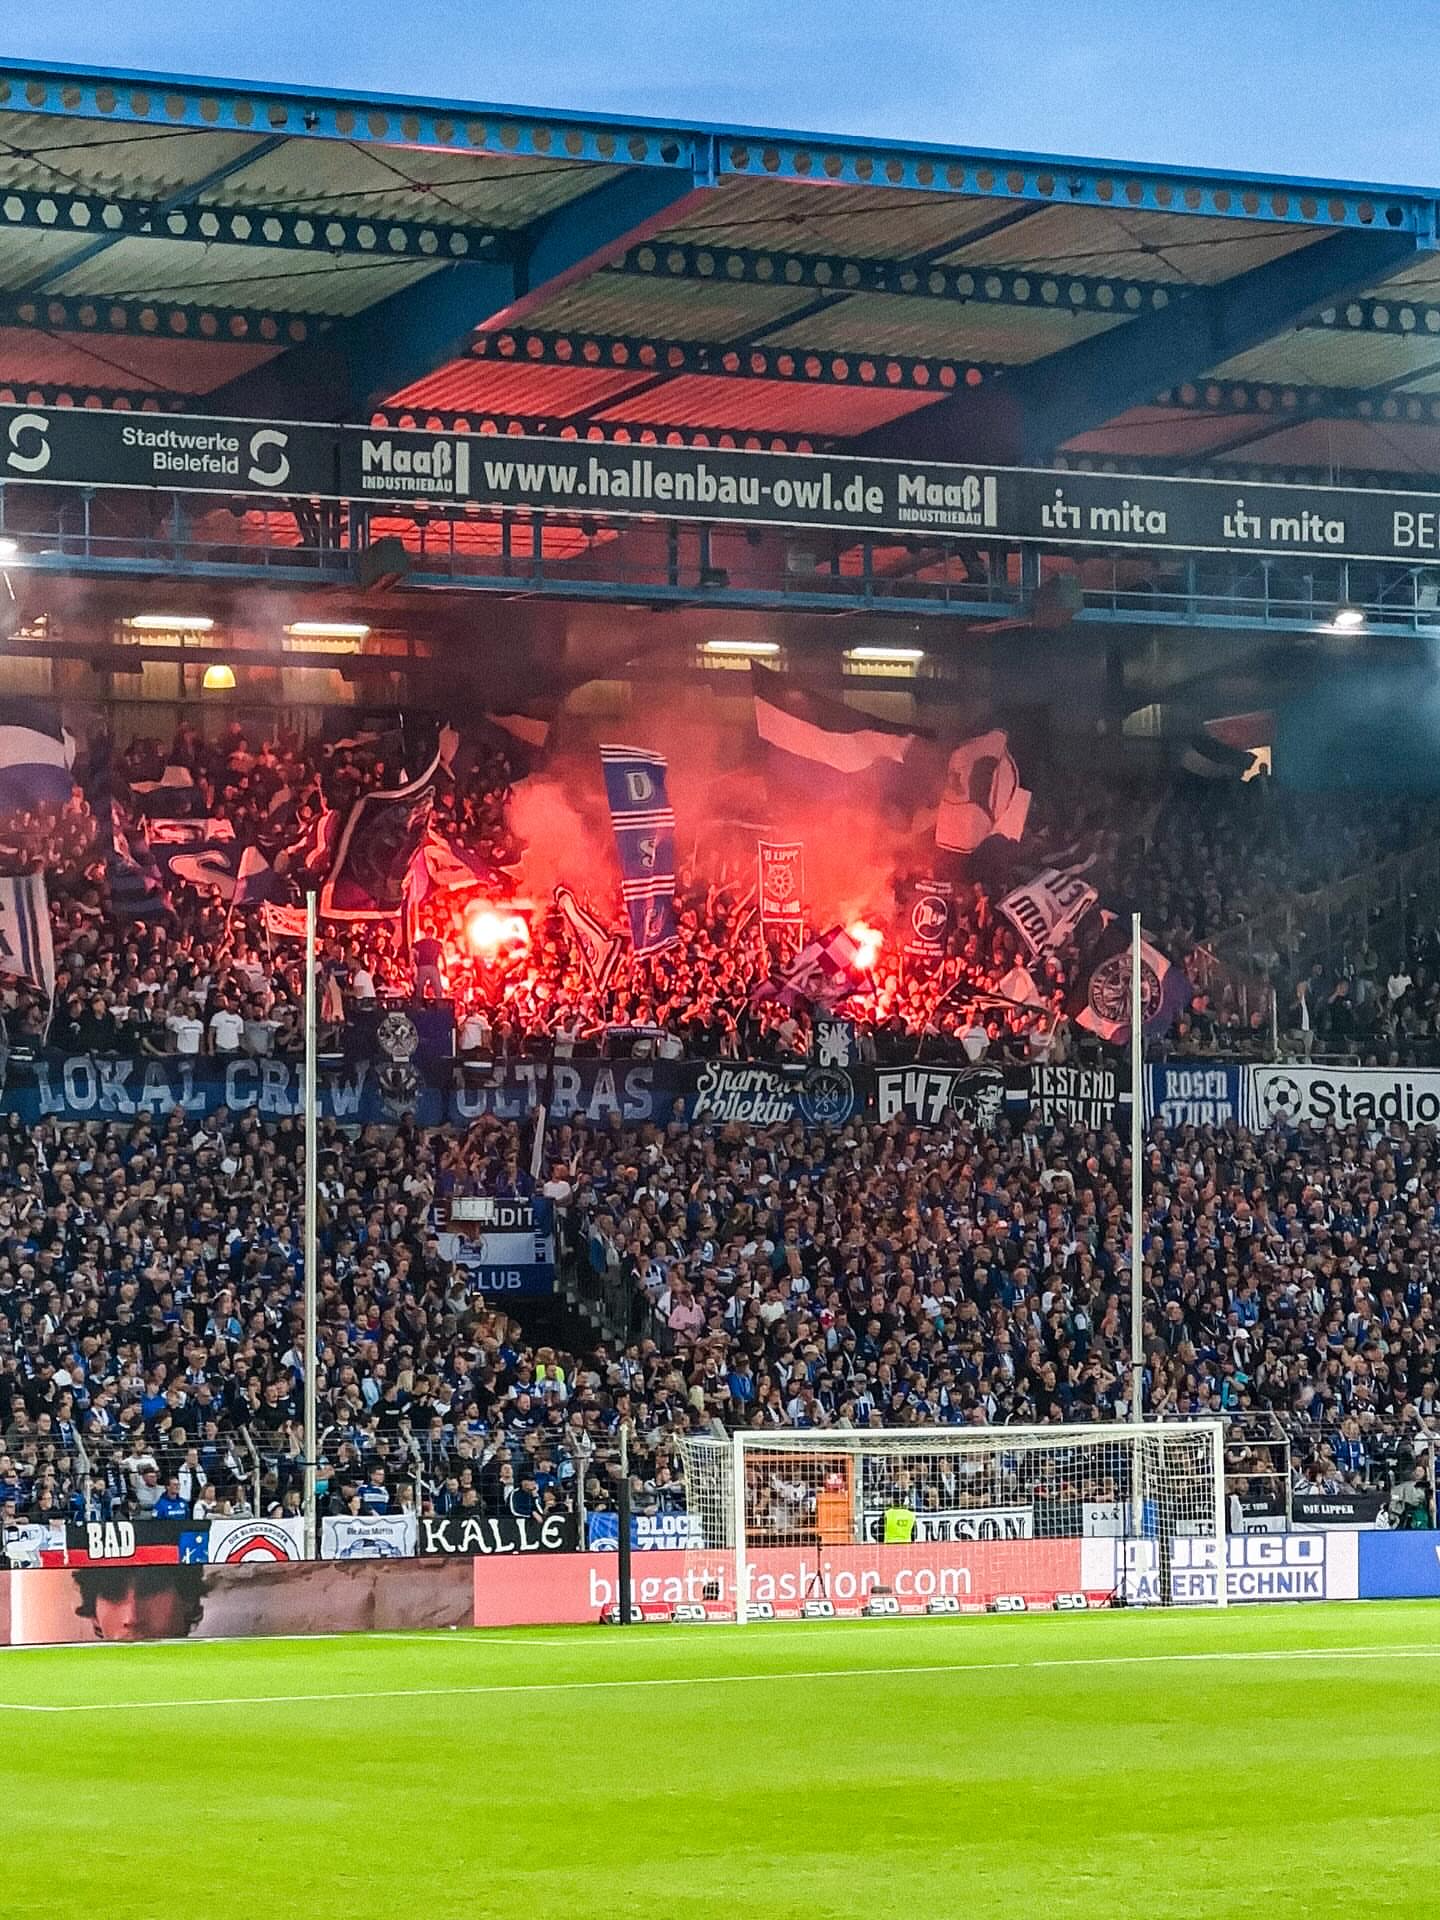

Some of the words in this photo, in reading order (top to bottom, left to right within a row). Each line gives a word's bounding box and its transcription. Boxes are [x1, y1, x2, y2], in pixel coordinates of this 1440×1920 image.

[121, 427, 240, 451] Stadtwerke
[152, 452, 239, 475] Bielefeld
[361, 439, 451, 478] Maaß
[361, 474, 453, 493] INDUSTRIEBAU
[483, 456, 884, 515] www.hallenbau-owl.de
[898, 474, 981, 512] Maaß
[898, 507, 981, 525] INDUSTRIEBAU
[1089, 500, 1167, 534] mita
[1269, 511, 1345, 544] mita
[1393, 511, 1440, 549] BE
[33, 1057, 206, 1115] LOKAL
[1165, 1070, 1228, 1100] ROSEN
[1160, 1100, 1232, 1130] STURM
[86, 1521, 135, 1559] BAD
[423, 1516, 566, 1553] KALLE
[636, 1516, 702, 1535] BLOCK
[588, 1562, 972, 1608] bgatti-fashioncom
